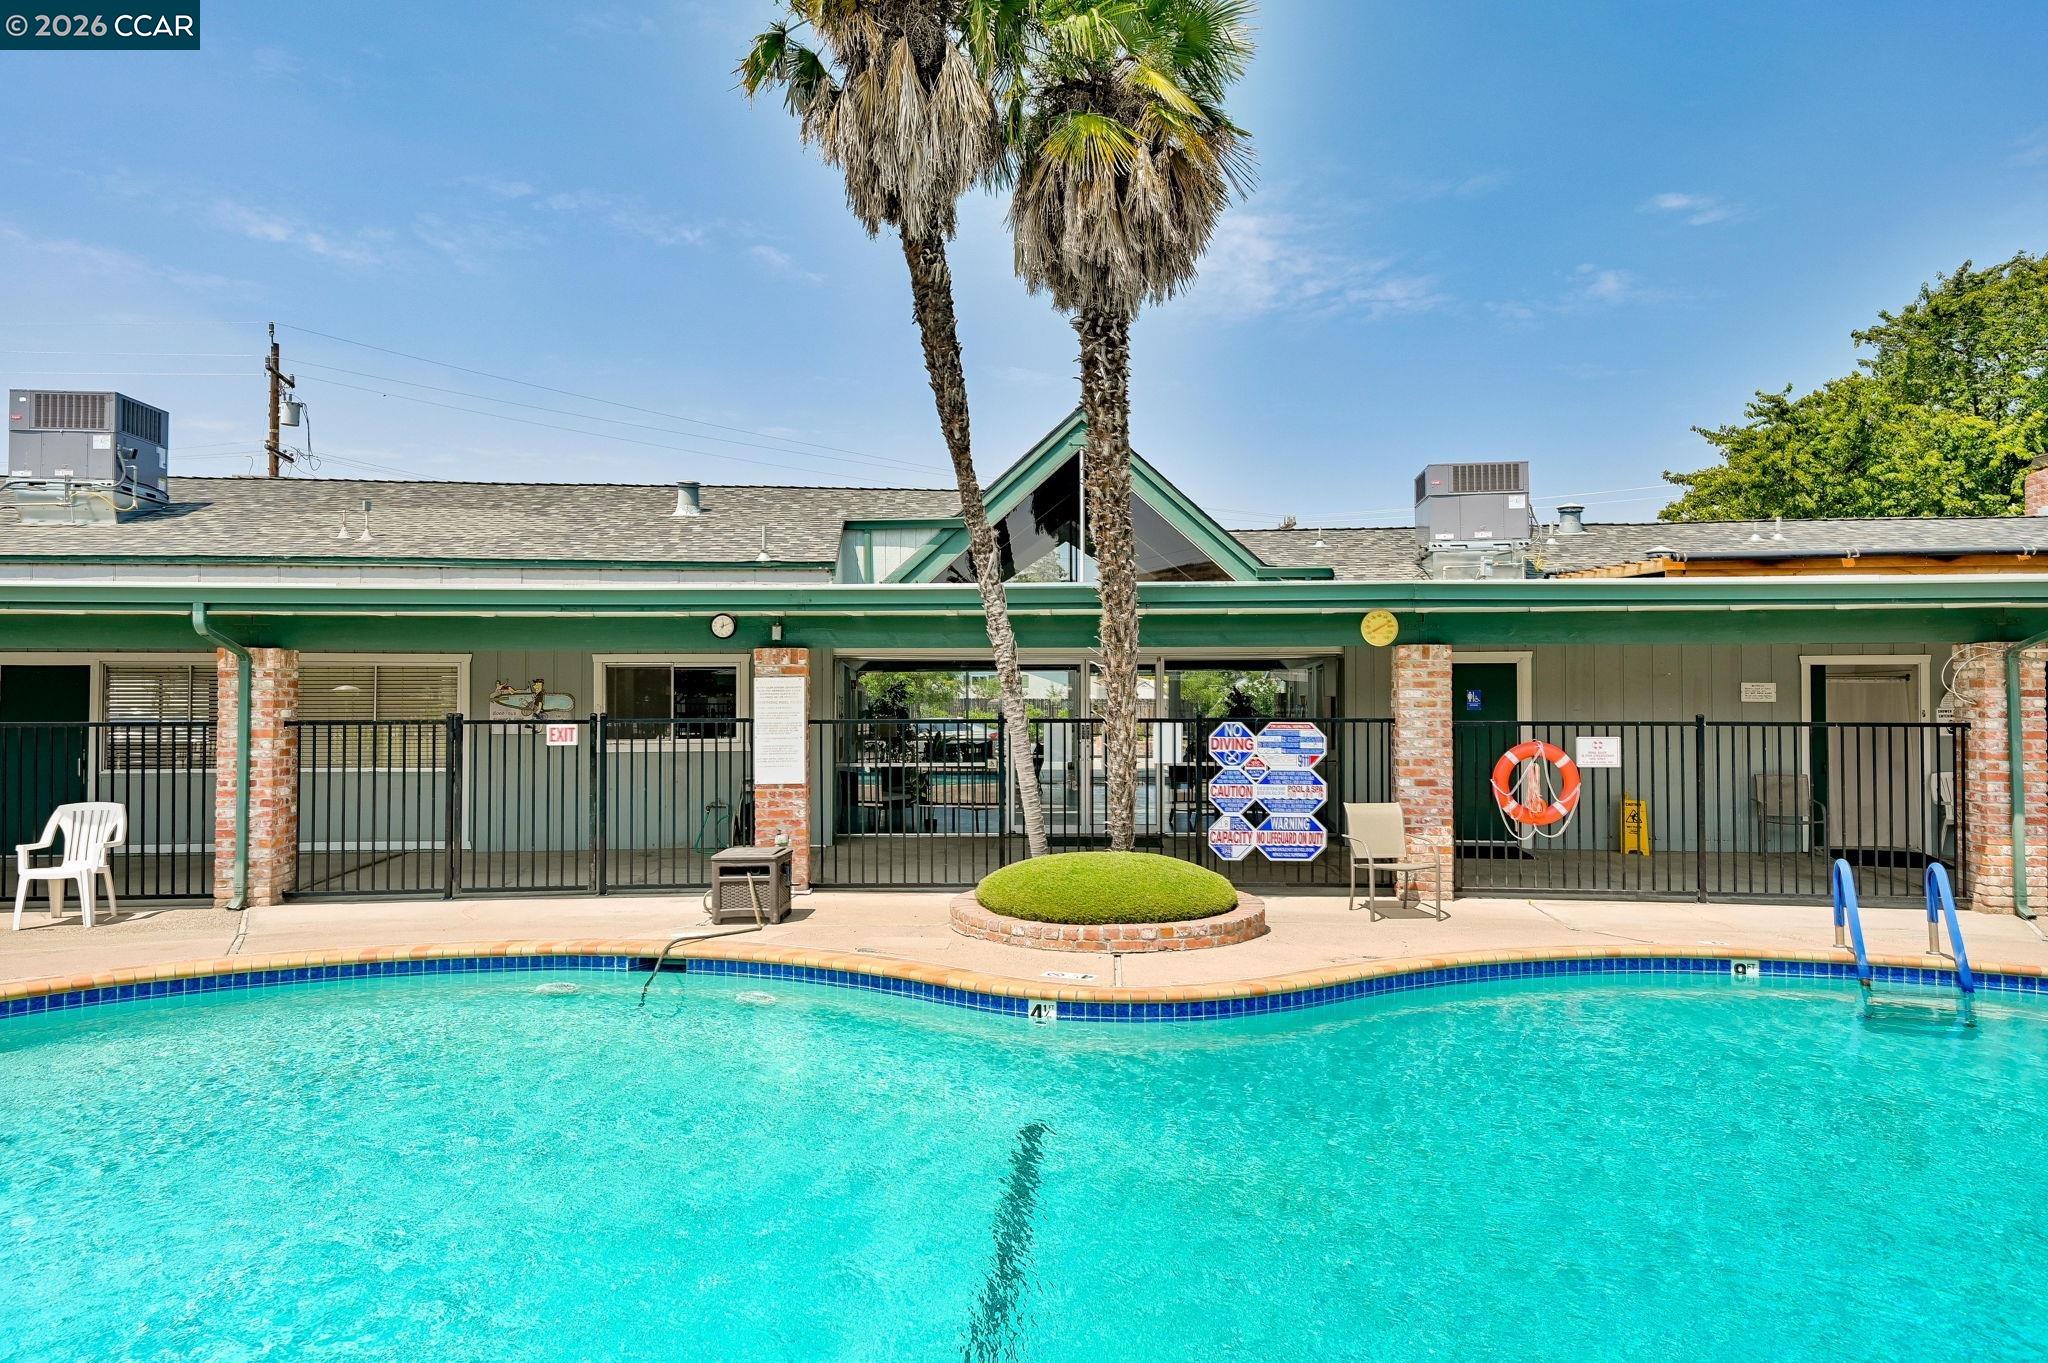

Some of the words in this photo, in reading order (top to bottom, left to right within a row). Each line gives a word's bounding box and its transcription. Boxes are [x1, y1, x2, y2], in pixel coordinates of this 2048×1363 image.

[549, 727, 576, 742] EXIT
[1224, 723, 1242, 737] NO
[1210, 737, 1254, 751] DIVING
[1297, 754, 1310, 768] 911
[1210, 785, 1254, 798] CAUTION
[1287, 785, 1305, 793] POOL
[1311, 785, 1324, 794] SPA
[1270, 816, 1311, 831] WARNING
[1209, 831, 1253, 844] CAPACITY
[1256, 831, 1266, 844] NO
[1266, 831, 1297, 844] LIFEGUARD
[1298, 831, 1308, 844] ON
[1309, 831, 1323, 844] DUTY
